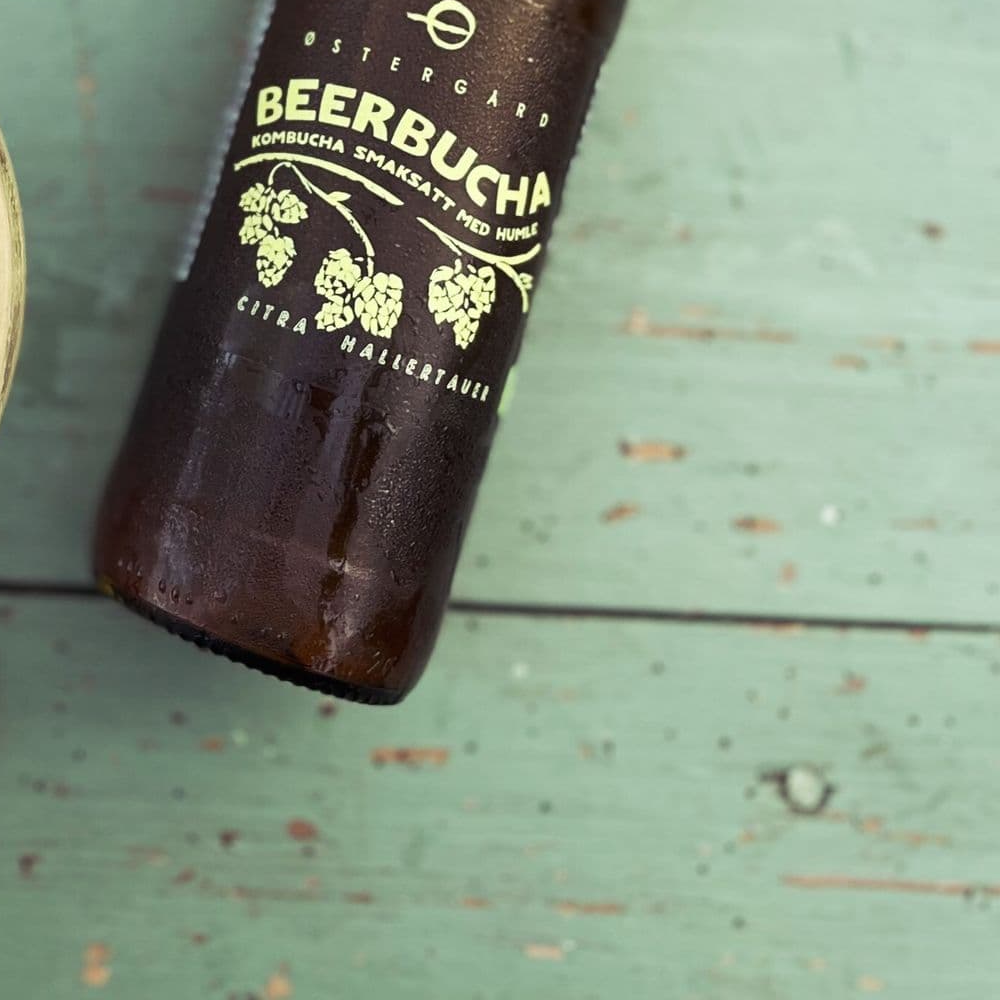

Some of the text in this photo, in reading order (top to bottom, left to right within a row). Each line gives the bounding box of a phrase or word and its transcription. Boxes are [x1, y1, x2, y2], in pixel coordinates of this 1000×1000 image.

[251, 130, 539, 242] KOMBUCHA SMAKSATT MED HUMLE
[256, 79, 551, 217] BEERBUCHA
[237, 295, 307, 335] CITRA
